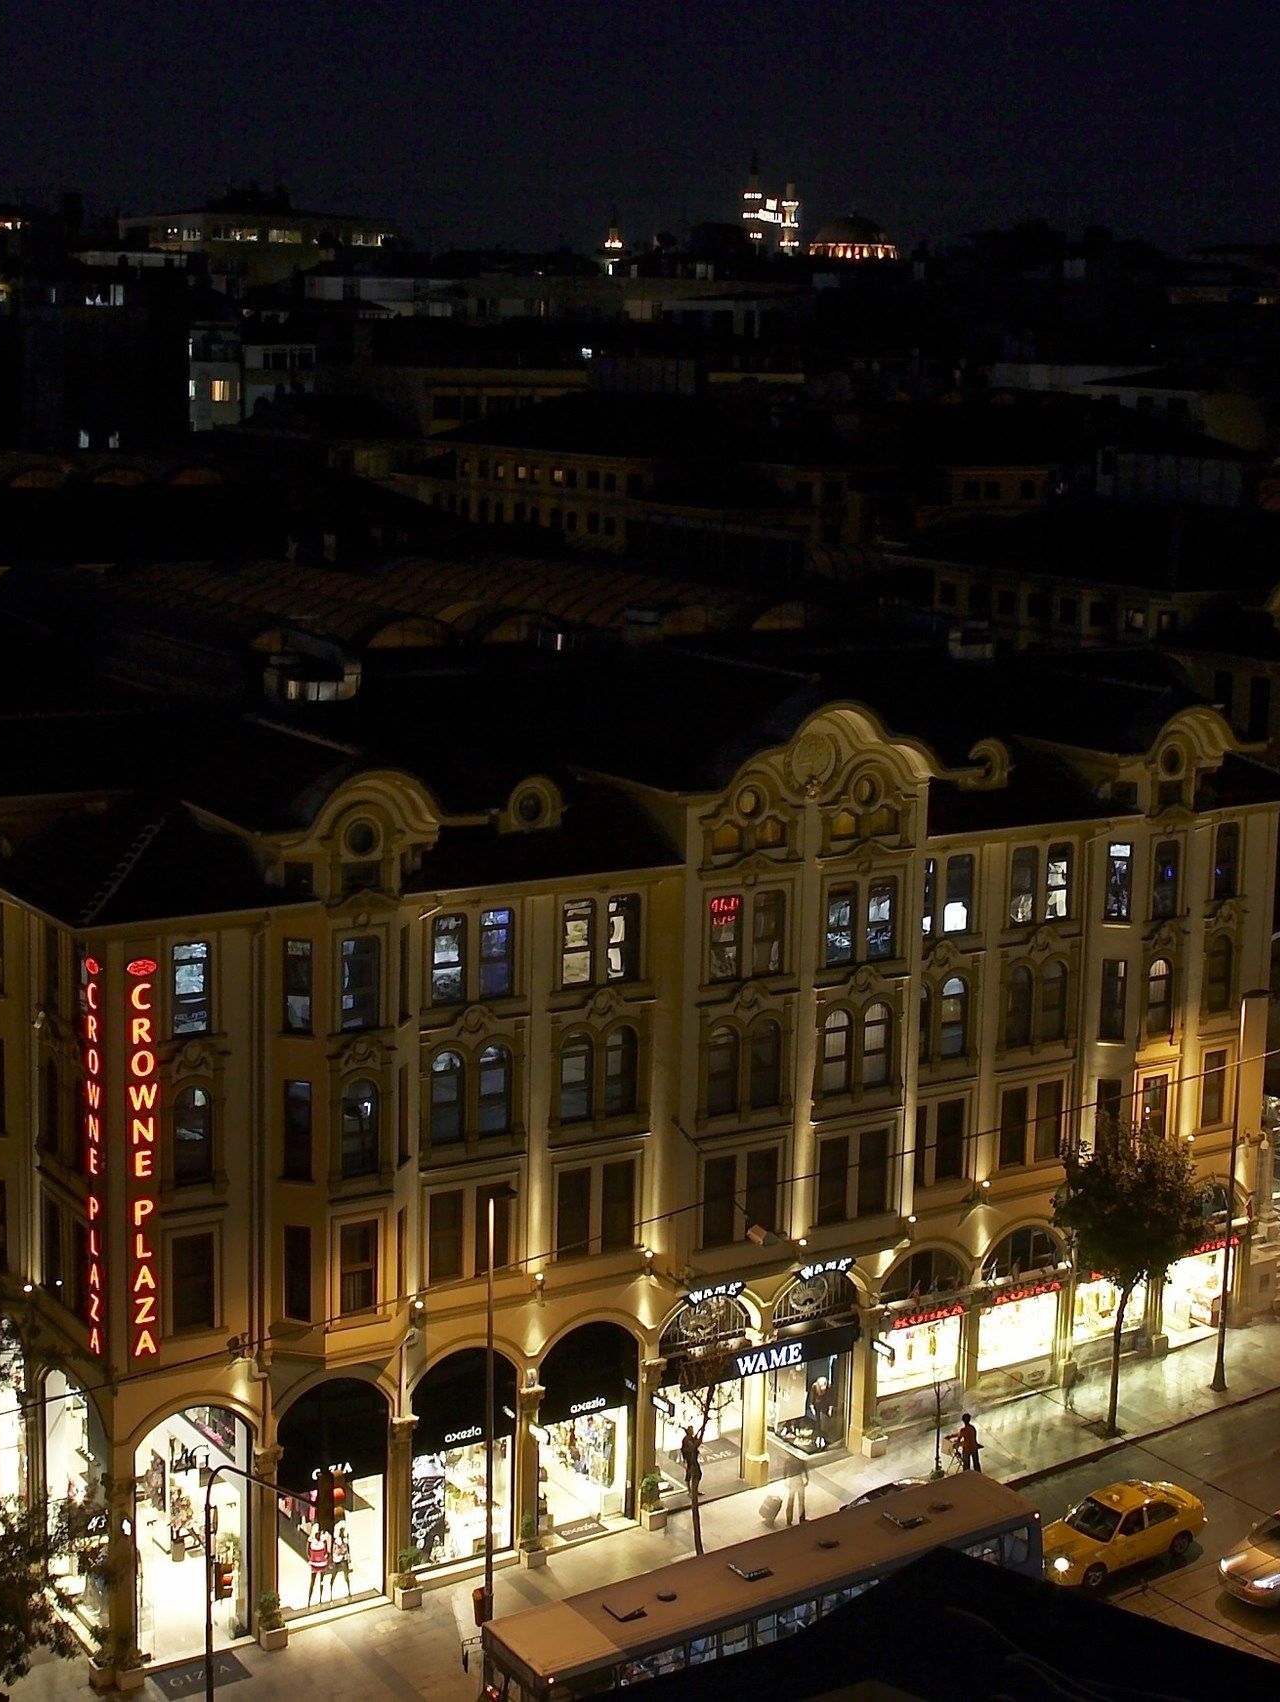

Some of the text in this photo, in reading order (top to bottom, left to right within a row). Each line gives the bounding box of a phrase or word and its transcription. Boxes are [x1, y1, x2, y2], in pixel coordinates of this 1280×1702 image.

[127, 982, 158, 1178] CROWNE
[86, 982, 101, 1355] CROWNE PLAZA
[133, 1199, 157, 1357] PLAZA
[799, 1256, 854, 1281] WAME
[688, 1280, 744, 1306] WAME
[736, 1342, 803, 1377] WAME
[570, 1396, 607, 1415] axezia
[444, 1425, 482, 1444] axezia
[311, 1461, 354, 1482] GZIA
[168, 1664, 232, 1689] GIZA
